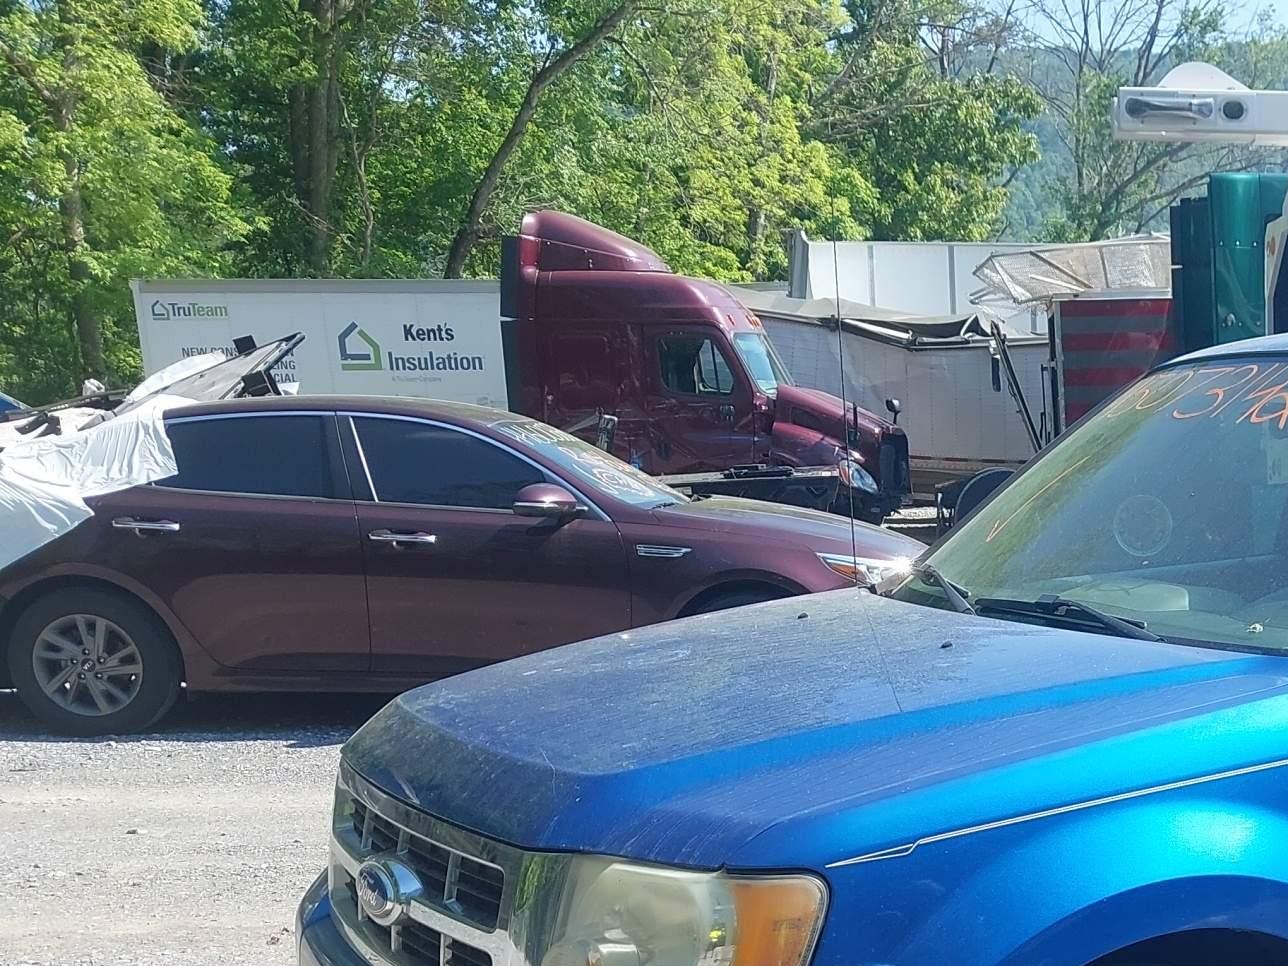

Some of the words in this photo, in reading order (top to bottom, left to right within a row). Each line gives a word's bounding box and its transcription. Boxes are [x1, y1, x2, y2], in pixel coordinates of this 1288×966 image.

[168, 302, 228, 317] TruTeam
[403, 321, 455, 342] Kent's
[387, 351, 484, 371] Insulation
